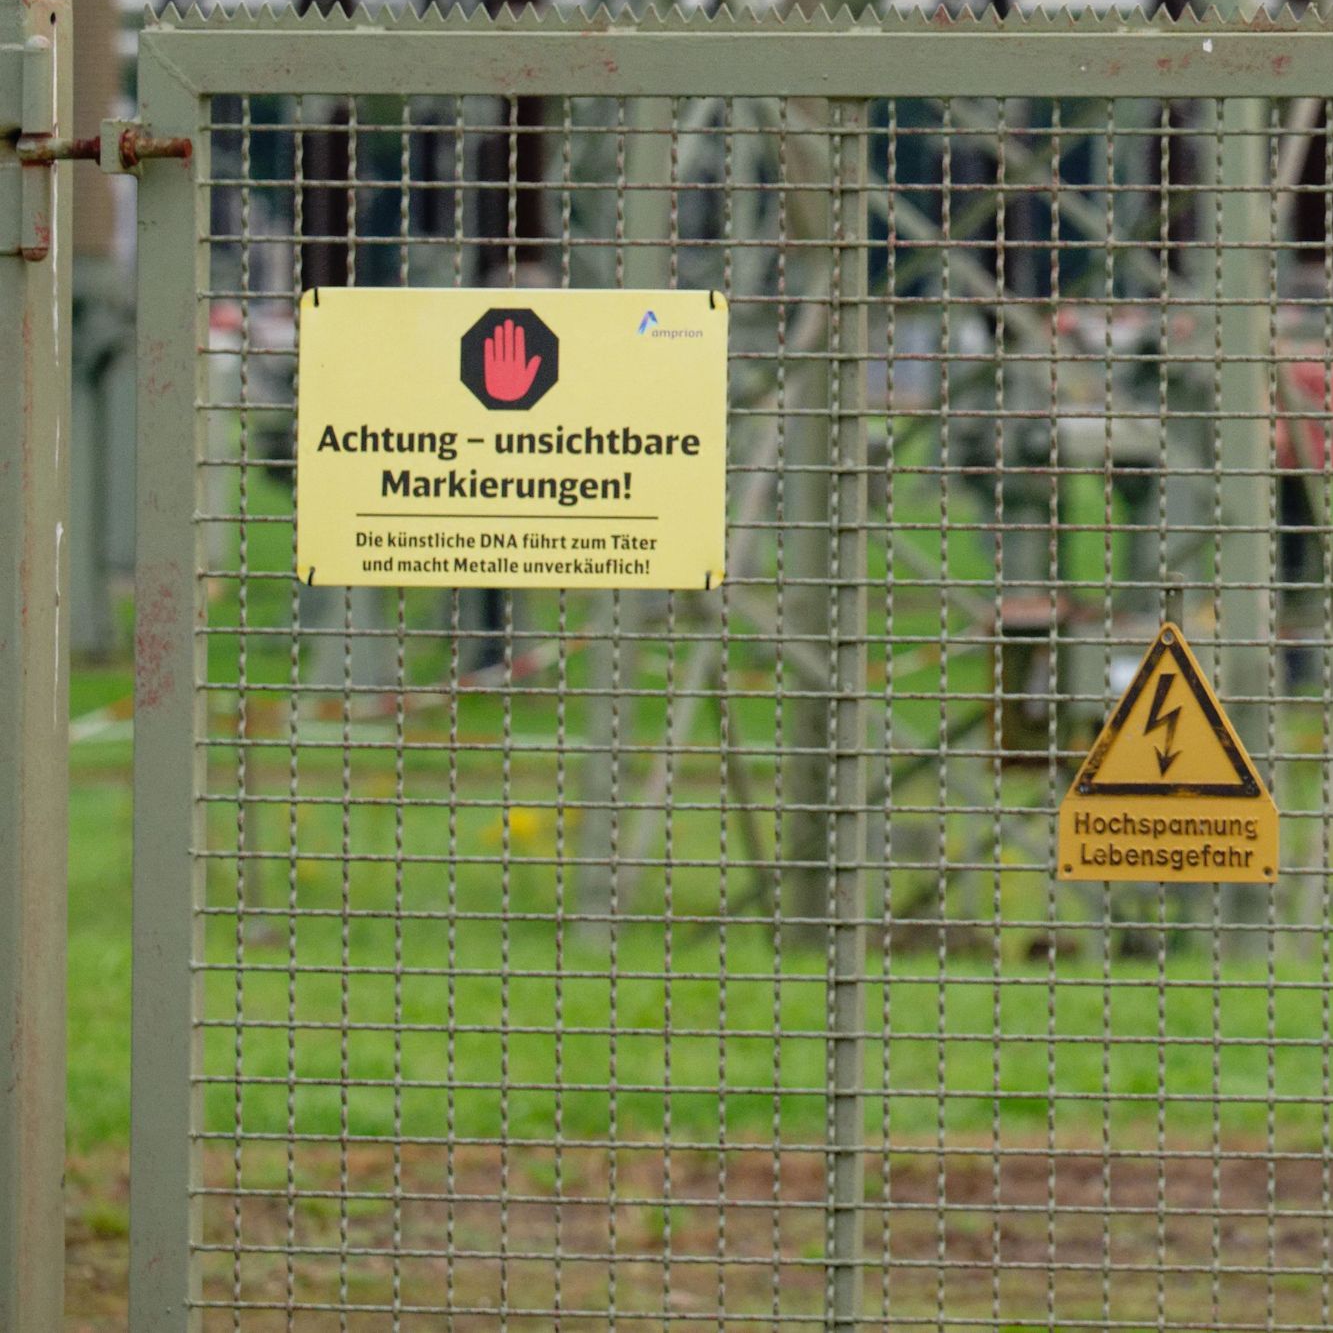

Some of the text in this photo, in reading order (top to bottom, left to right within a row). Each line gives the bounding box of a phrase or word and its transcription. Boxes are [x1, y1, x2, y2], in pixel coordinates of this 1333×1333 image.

[650, 327, 703, 340] amprion
[317, 424, 458, 461] Achtung
[495, 425, 700, 455] unsichtbare
[382, 469, 631, 506] Markierungen!
[356, 532, 657, 550] Die künstliche DNA führt zum Täter
[363, 557, 649, 574] und macht Metalle unverkäuflich!
[1074, 812, 1258, 839] Hochspannung
[1081, 843, 1253, 870] Lebensgefahr
